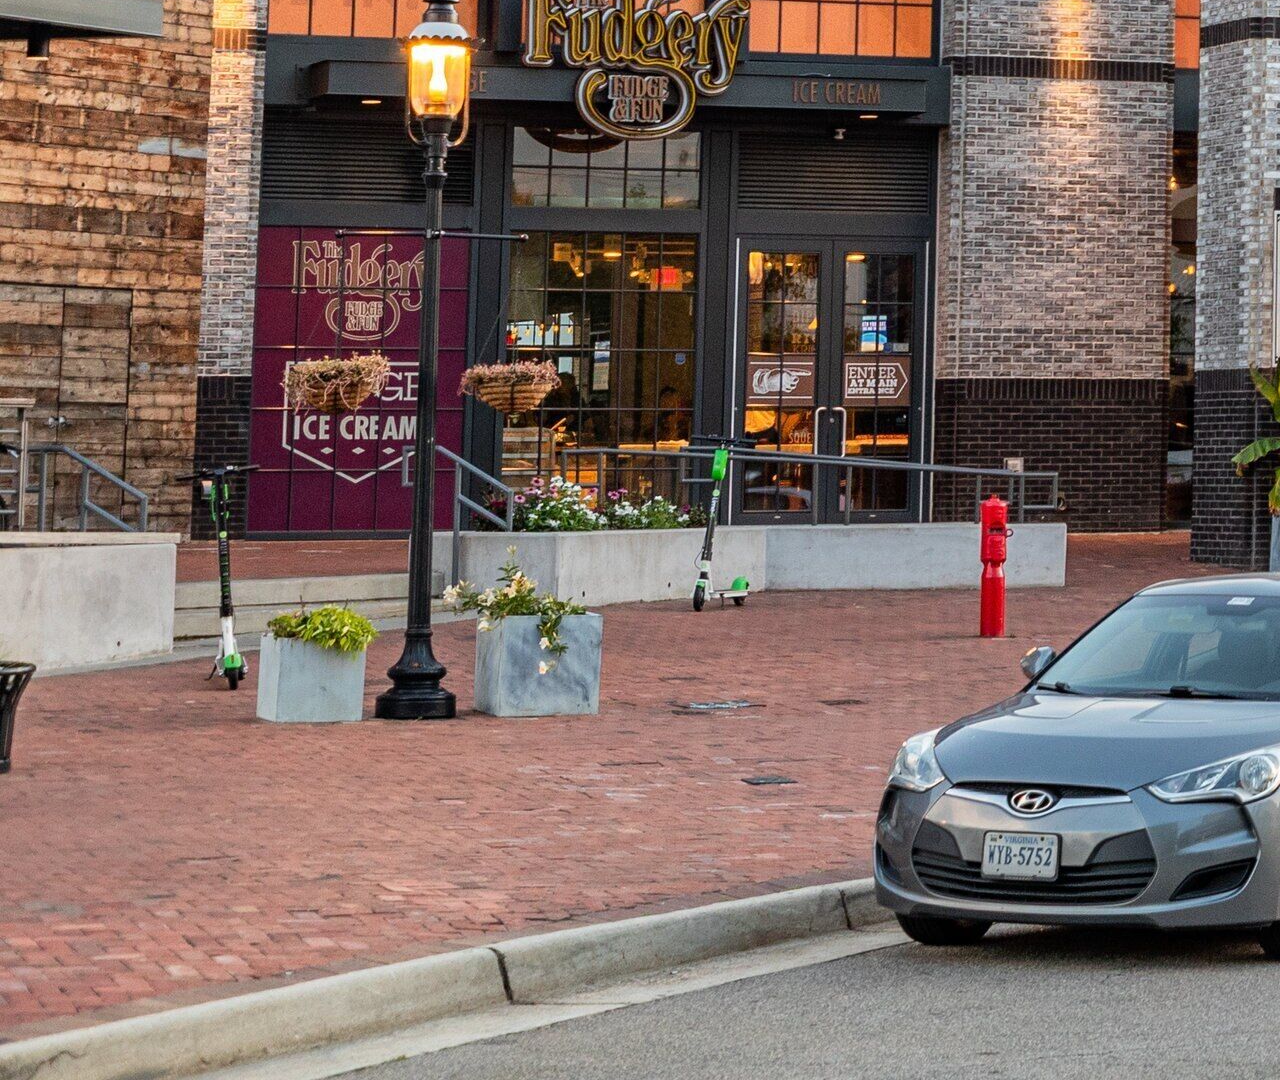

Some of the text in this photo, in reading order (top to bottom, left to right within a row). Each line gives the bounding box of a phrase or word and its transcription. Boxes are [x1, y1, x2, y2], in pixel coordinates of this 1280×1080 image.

[608, 73, 670, 101] FUDGE
[792, 80, 882, 106] ICE CREAM
[344, 300, 384, 317] FUDGE
[848, 366, 896, 379] ENTER
[847, 387, 895, 395] ENTRANCE
[850, 379, 898, 388] AT MAIN
[293, 415, 417, 441] ICE CREAM
[1003, 834, 1039, 845] VIRGINIA
[988, 844, 1053, 867] WYB-5752
